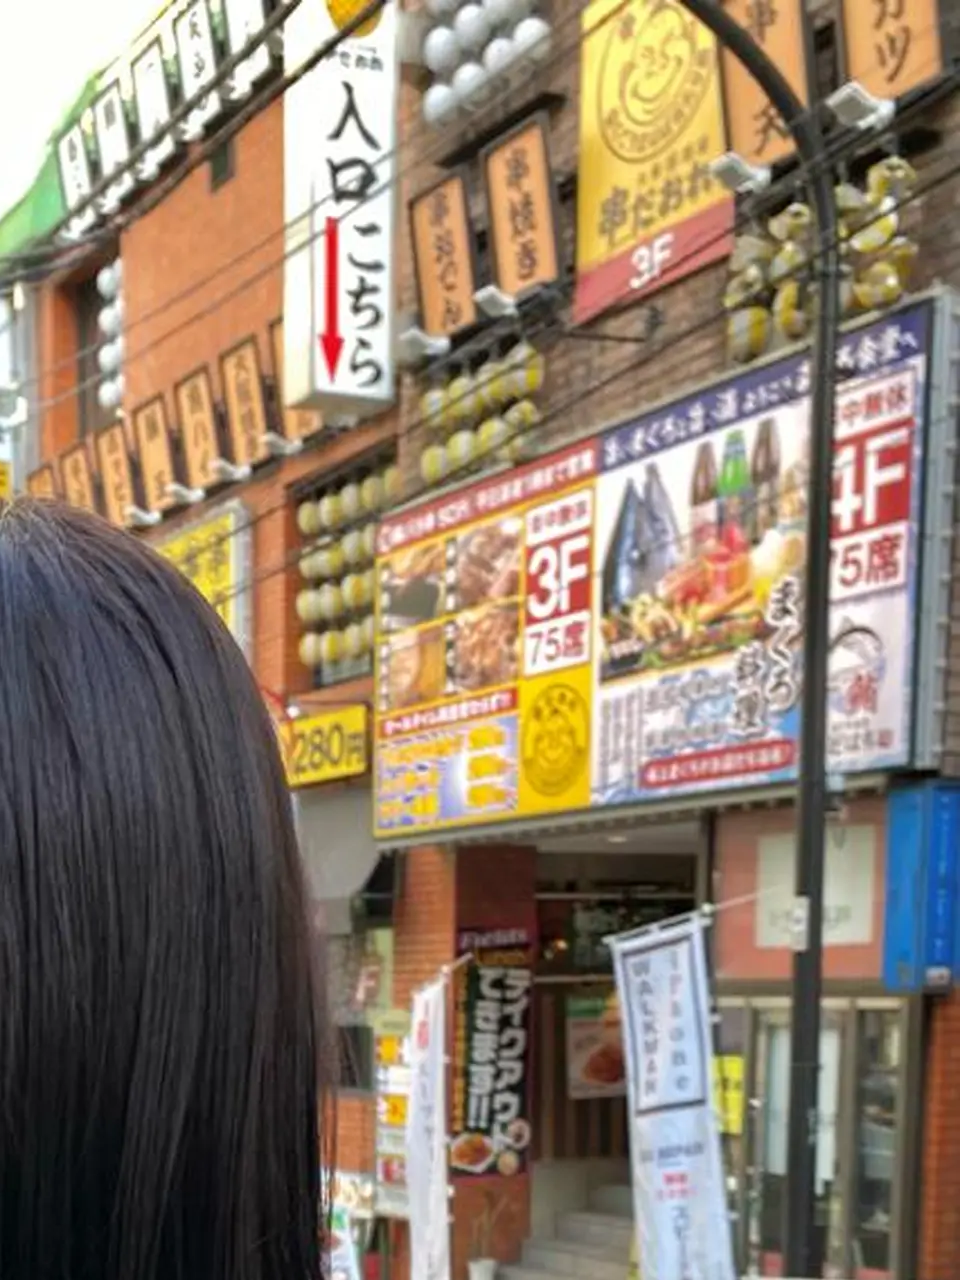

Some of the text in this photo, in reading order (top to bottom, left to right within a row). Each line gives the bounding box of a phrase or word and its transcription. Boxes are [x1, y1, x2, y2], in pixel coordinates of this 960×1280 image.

[840, 381, 908, 425] 中無休
[528, 535, 589, 619] 3F
[833, 533, 903, 588] 5席
[529, 619, 586, 668] 75席
[630, 957, 658, 1095] WALKMAN
